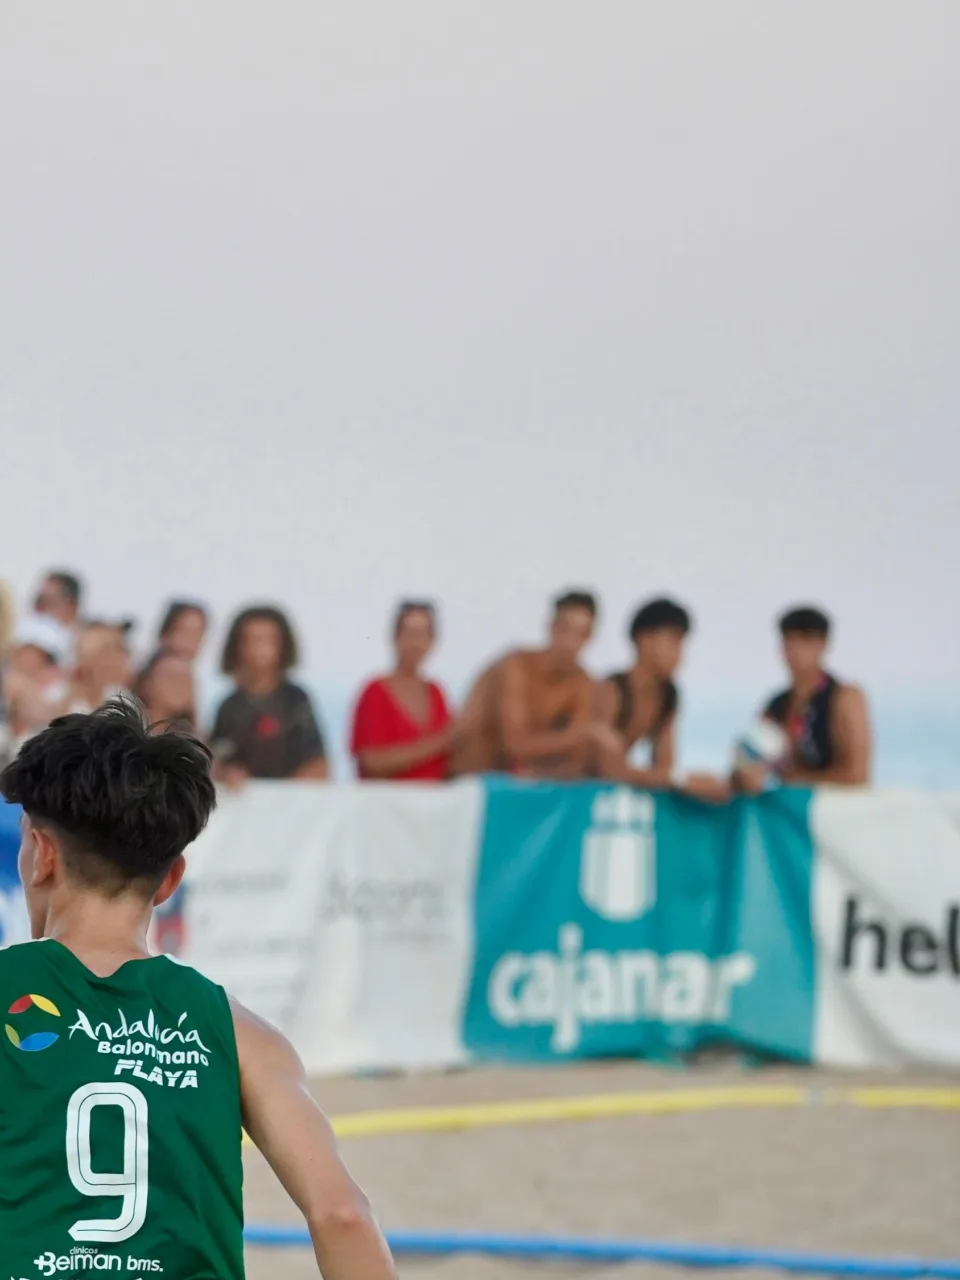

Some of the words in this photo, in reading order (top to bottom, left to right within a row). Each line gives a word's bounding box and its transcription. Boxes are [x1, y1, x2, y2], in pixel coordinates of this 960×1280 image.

[840, 896, 960, 976] hel
[488, 923, 756, 1052] cajanar
[97, 1038, 209, 1067] Balonmano
[113, 1058, 198, 1089] PLAYA
[66, 1081, 148, 1243] 9
